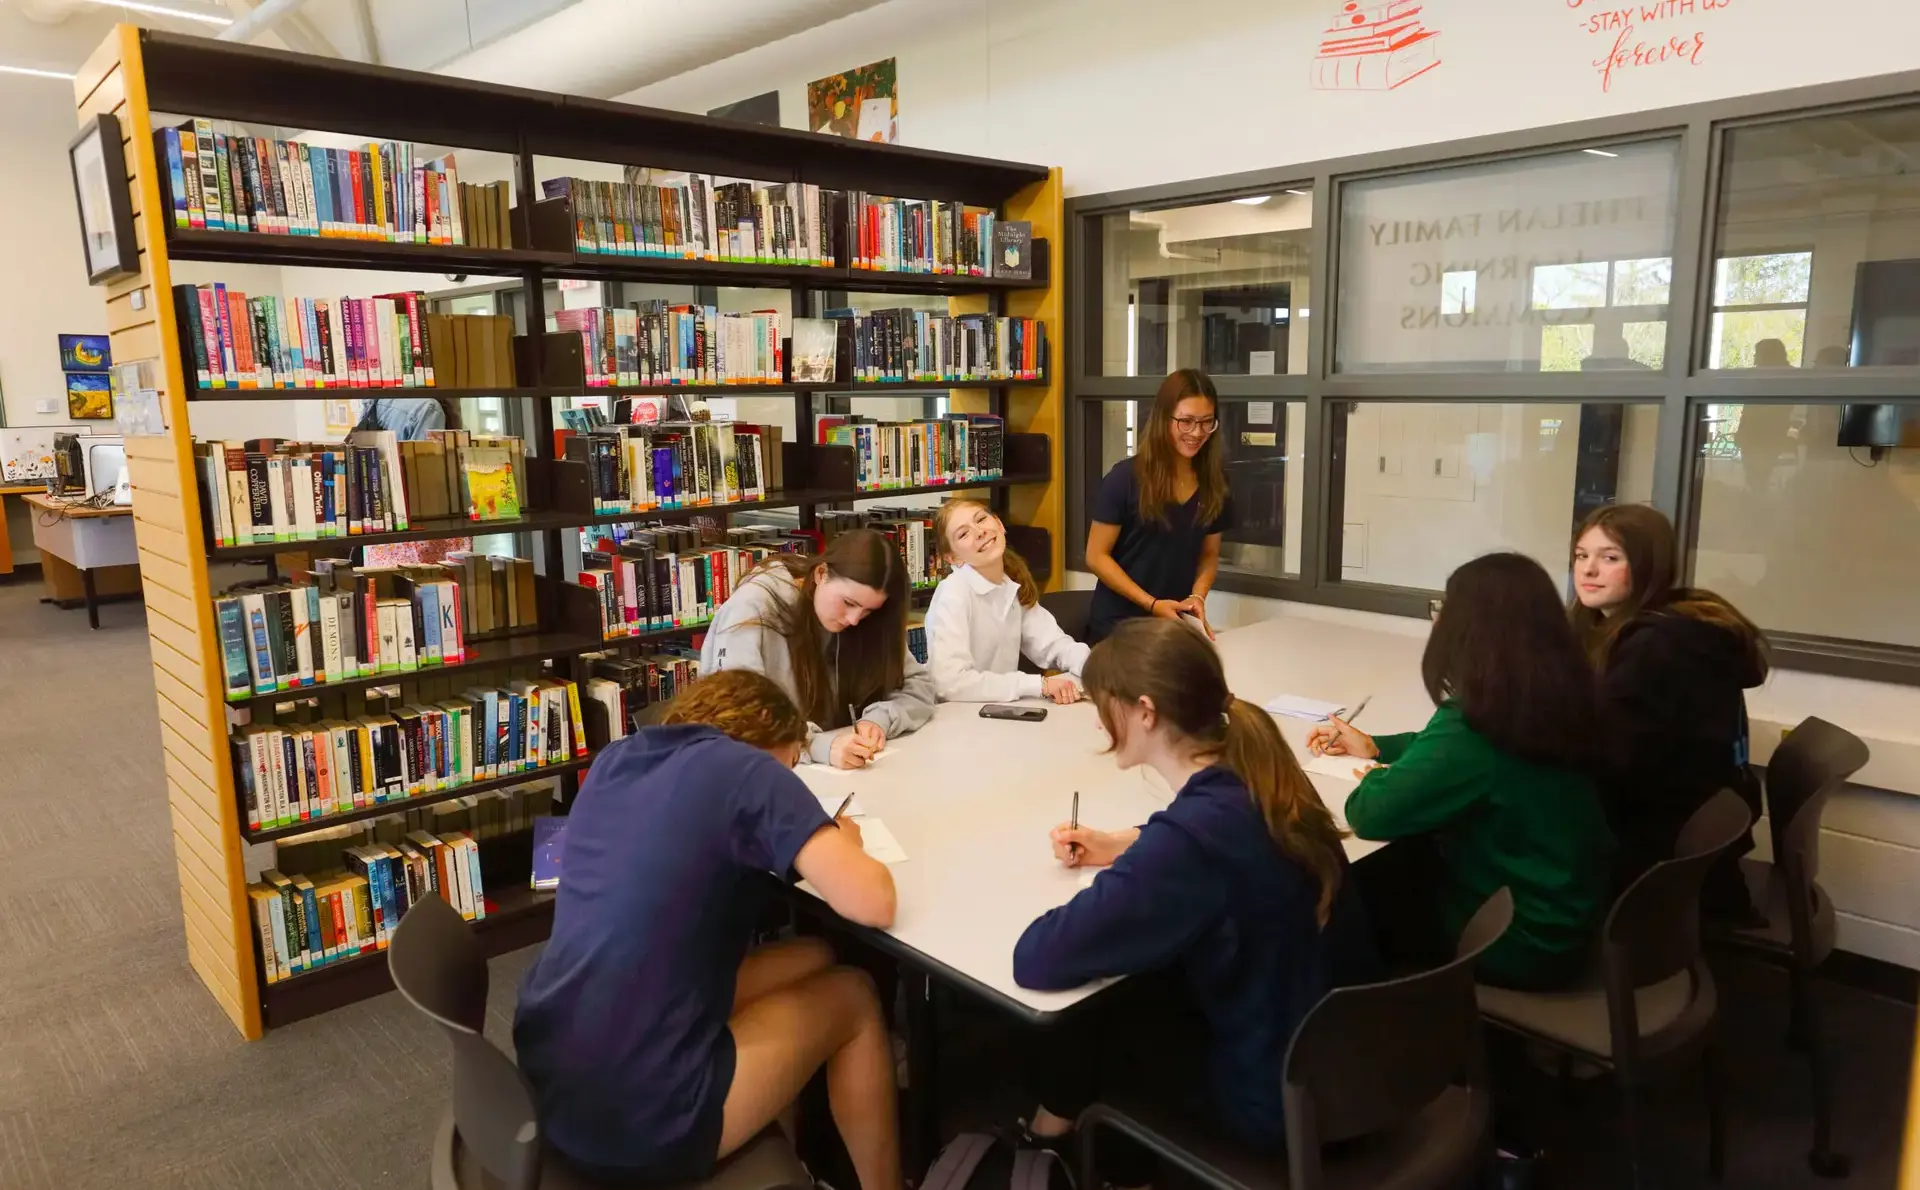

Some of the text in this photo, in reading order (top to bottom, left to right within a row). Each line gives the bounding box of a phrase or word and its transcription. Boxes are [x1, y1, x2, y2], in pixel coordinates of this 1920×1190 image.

[1640, 0, 1694, 22] WITH
[1592, 25, 1705, 93] forever
[997, 231, 1026, 239] Midnight
[1000, 237, 1023, 245] Library
[341, 300, 352, 347] SARAH DESSEN
[352, 300, 360, 323] SARAH
[220, 318, 231, 345] BEFORE
[695, 331, 704, 368] CORRECTIO
[249, 468, 263, 518] COPPERFIELD
[258, 480, 269, 505] DAVID
[313, 470, 323, 515] Oliver Twist
[372, 498, 382, 519] STARS
[661, 583, 673, 607] FINALE
[280, 600, 294, 632] AKIN
[442, 604, 454, 629] K
[326, 616, 338, 661] DEMONS
[259, 773, 271, 804] WASHINGTON
[275, 770, 285, 799] WASHINGTON
[286, 921, 296, 936] park
